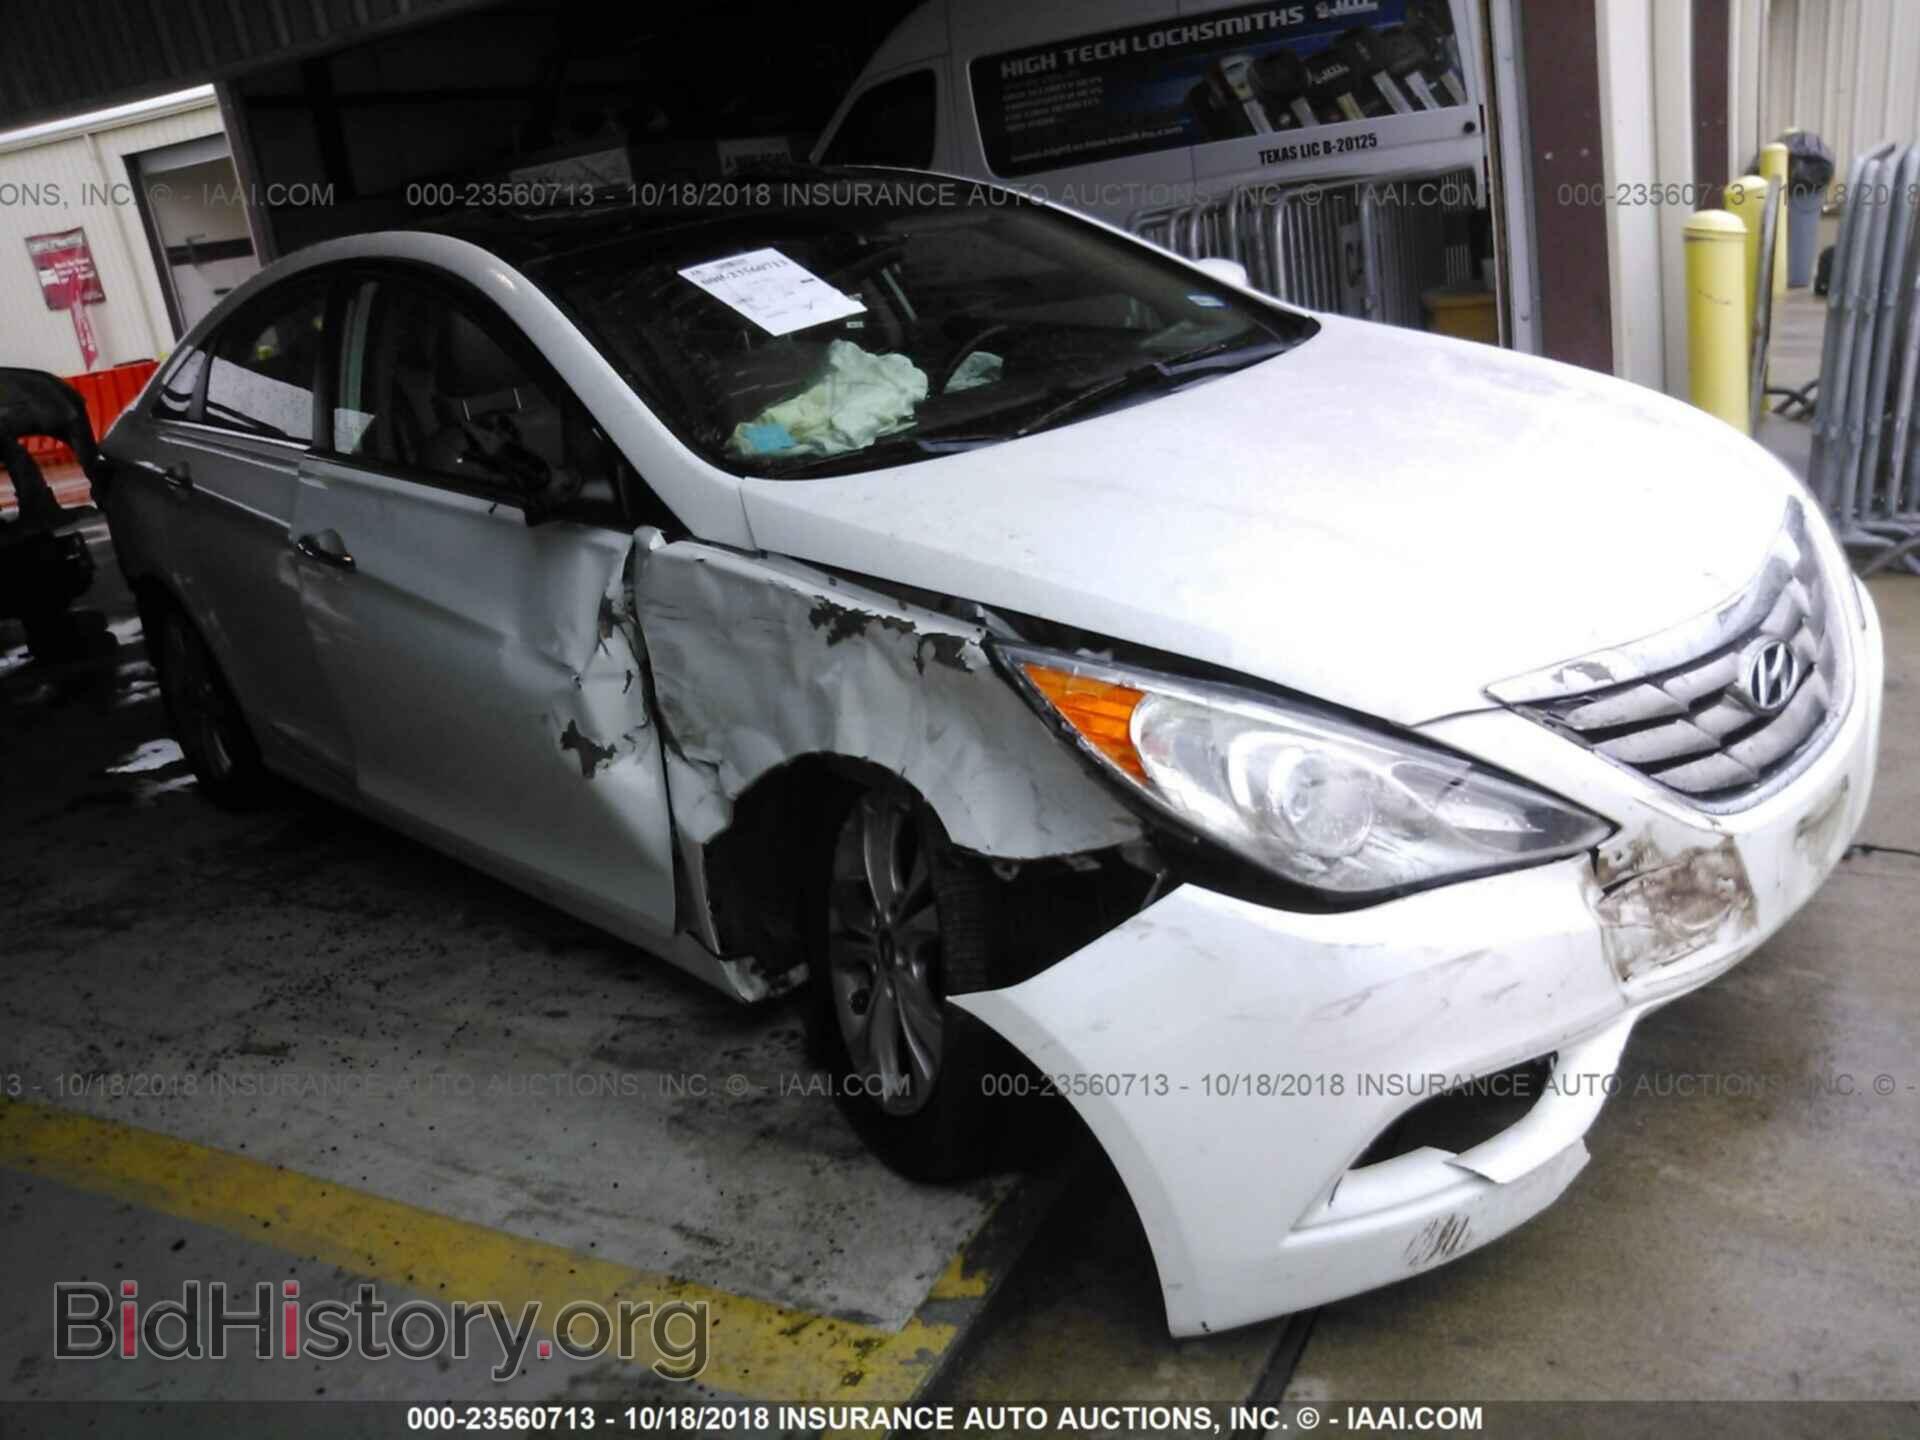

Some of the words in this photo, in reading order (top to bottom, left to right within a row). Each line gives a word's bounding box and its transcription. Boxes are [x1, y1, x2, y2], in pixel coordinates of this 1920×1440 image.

[1001, 51, 1057, 78] HIGH
[1064, 37, 1127, 65] TECH
[1258, 146, 1297, 165] TEXAS
[1300, 141, 1320, 158] LIC
[1323, 132, 1378, 155] B-20125
